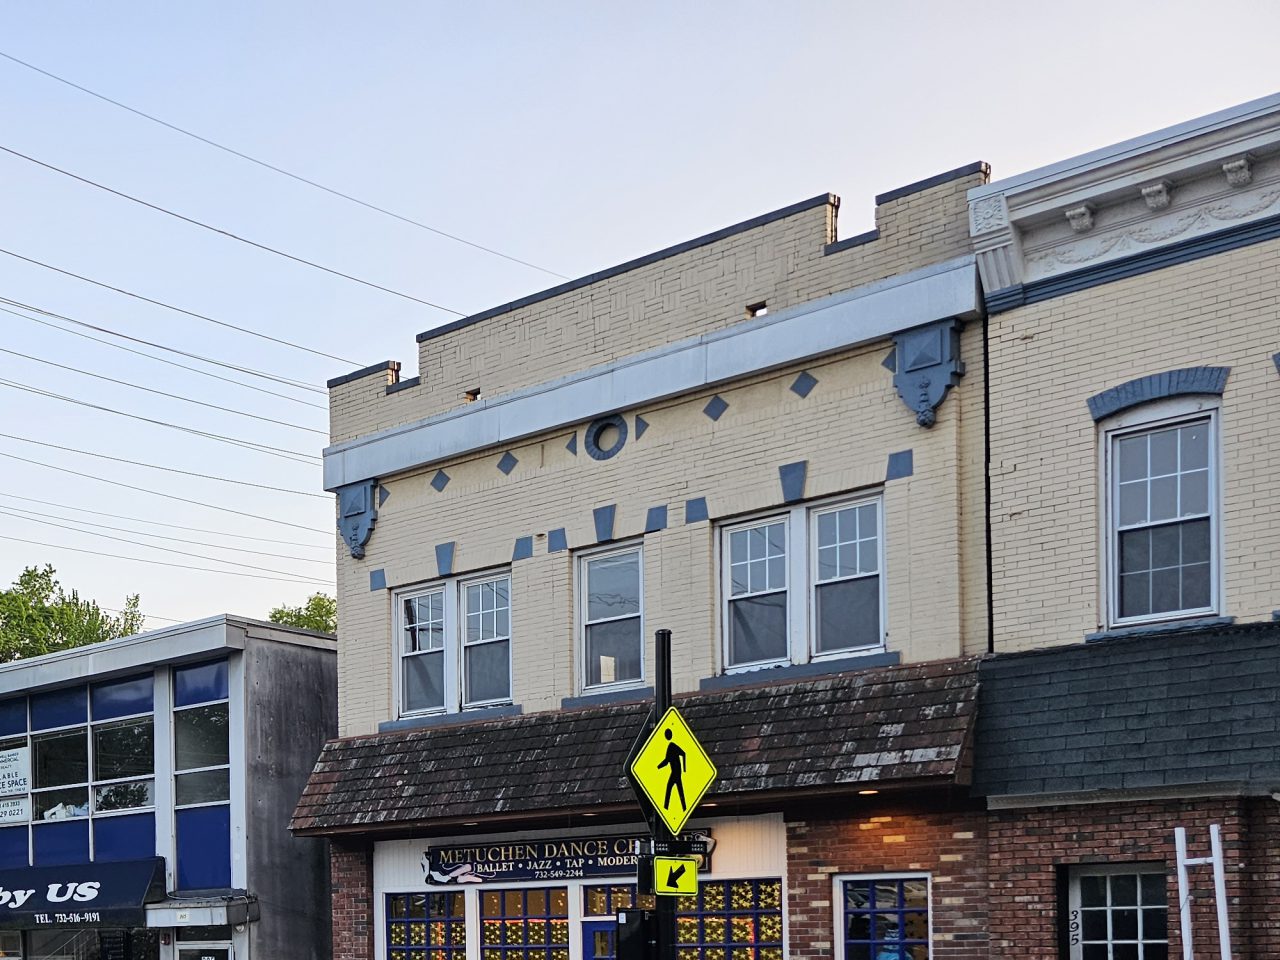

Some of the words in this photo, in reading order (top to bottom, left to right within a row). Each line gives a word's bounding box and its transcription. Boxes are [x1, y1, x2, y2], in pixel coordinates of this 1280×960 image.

[7, 778, 27, 788] SPACE
[438, 845, 538, 865] METUCHEN
[544, 840, 608, 858] DANCE
[477, 862, 514, 873] BALLET
[526, 860, 552, 870] JAZZ
[564, 858, 585, 868] TAP
[597, 856, 640, 867] MODER
[534, 869, 583, 879] 732-549-2244
[46, 881, 101, 902] US
[34, 914, 52, 924] TEL.
[55, 912, 100, 923] 732-516-9191
[1070, 910, 1079, 945] 395
